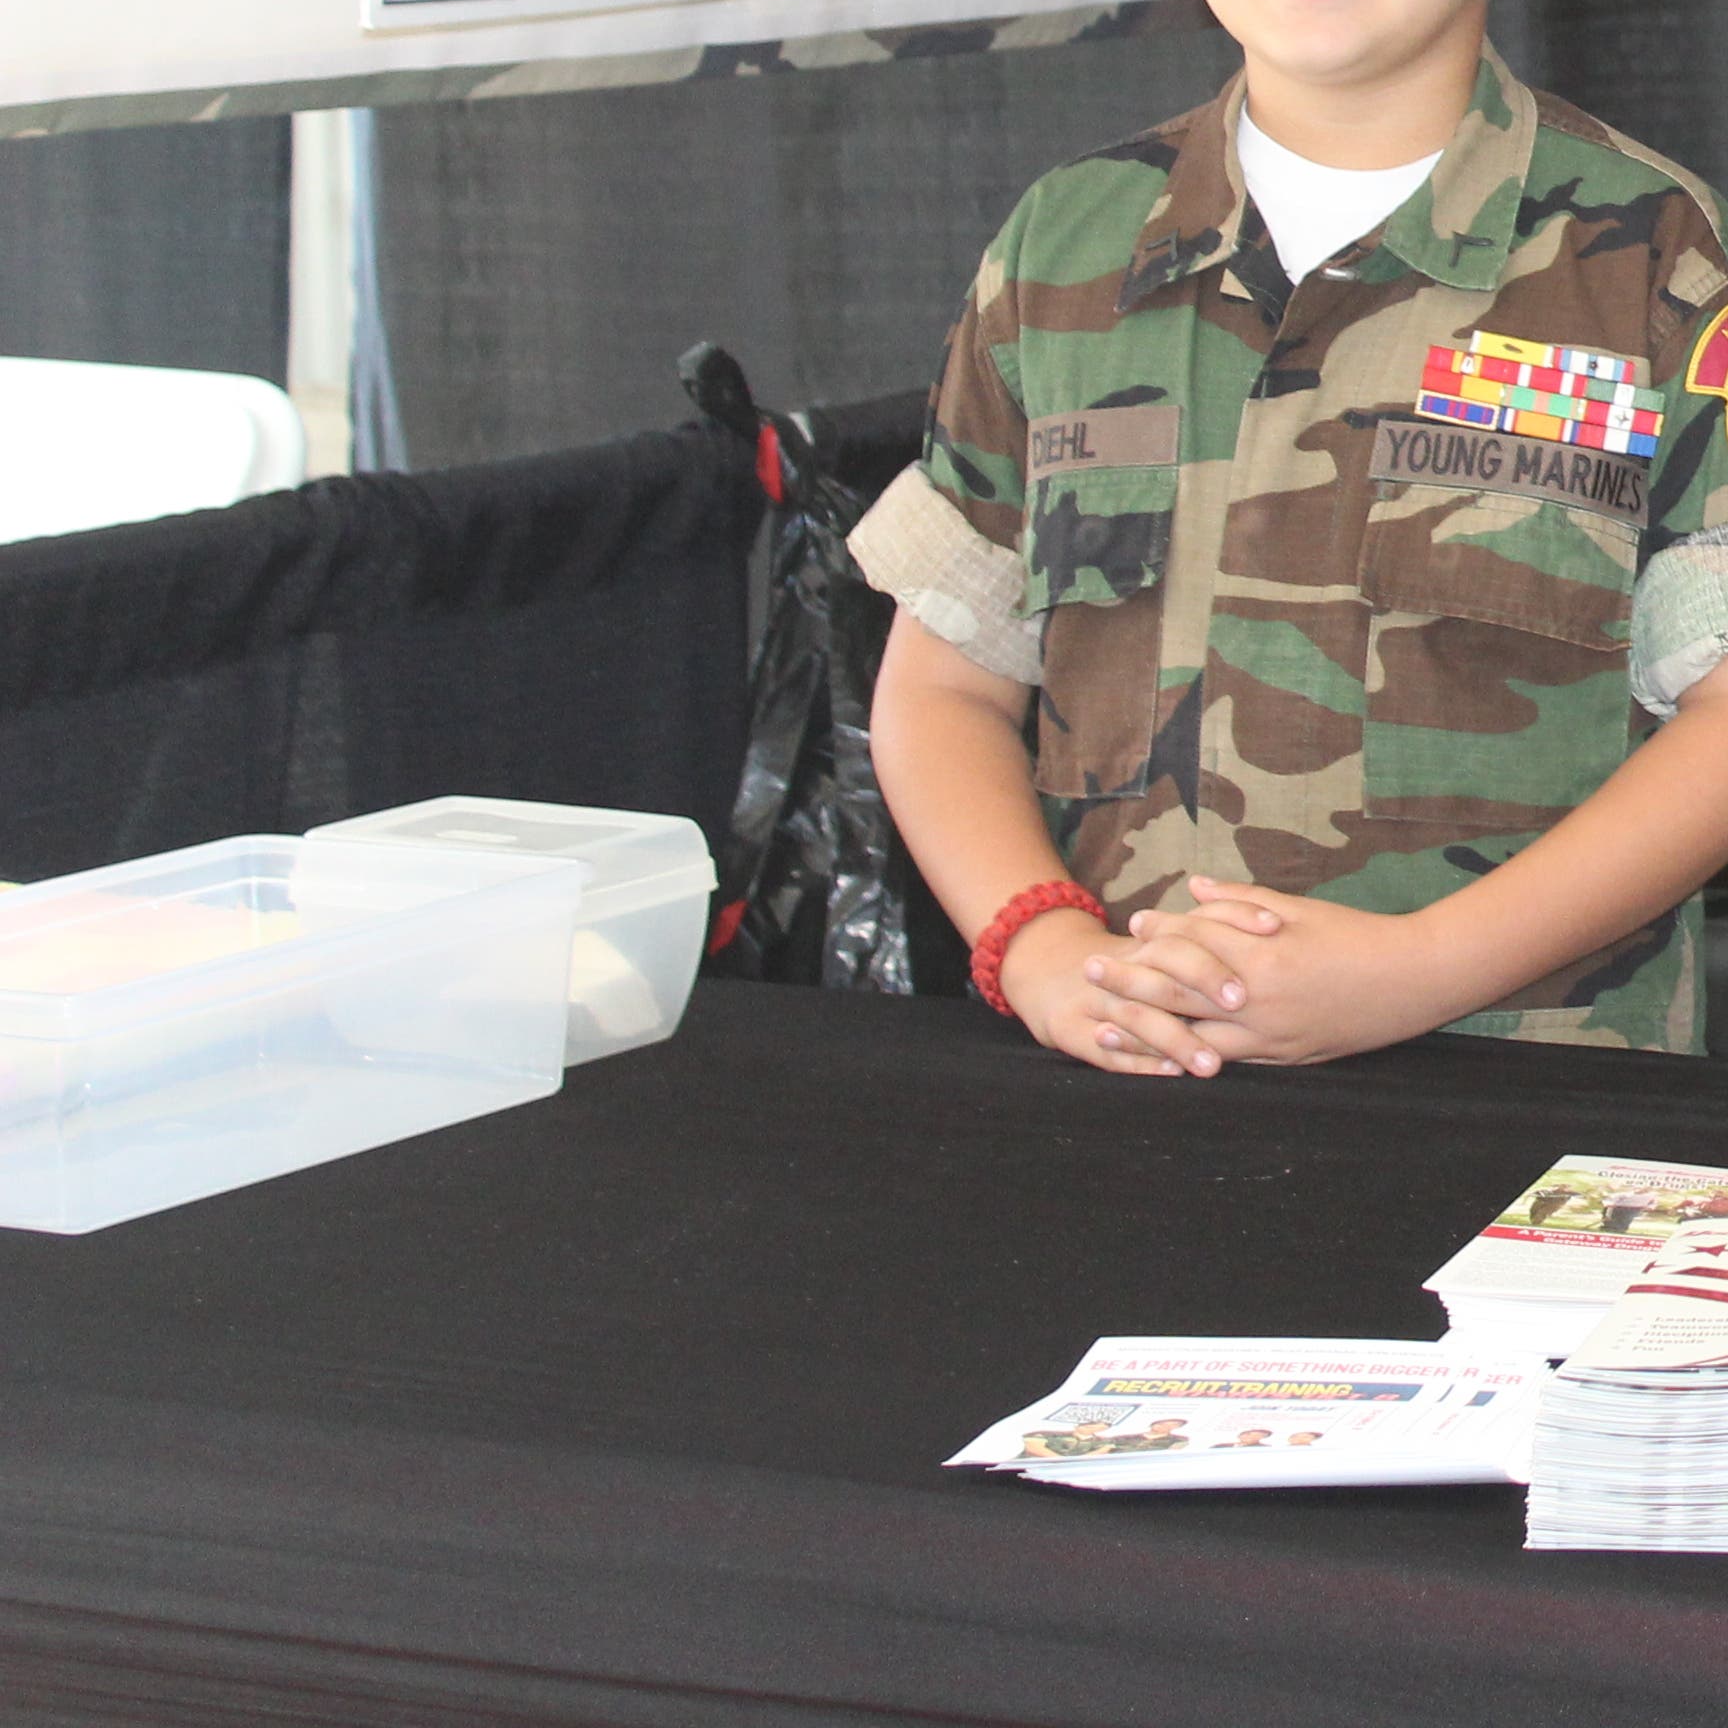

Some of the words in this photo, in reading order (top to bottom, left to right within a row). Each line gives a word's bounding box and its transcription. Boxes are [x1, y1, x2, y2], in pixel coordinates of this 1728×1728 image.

[1387, 426, 1503, 477] YOUNG
[1512, 444, 1645, 515] MARINES
[1543, 1236, 1613, 1248] Gateway
[1599, 1235, 1645, 1245] Guide
[1091, 1359, 1120, 1371] BE
[1123, 1360, 1138, 1371] A
[1142, 1360, 1202, 1372] PART
[1204, 1360, 1234, 1372] OF
[1237, 1361, 1366, 1374] SOMETHING
[1368, 1363, 1449, 1377] BIGGER
[1105, 1379, 1229, 1395] RECRUIT
[1228, 1381, 1354, 1397] TRAINING
